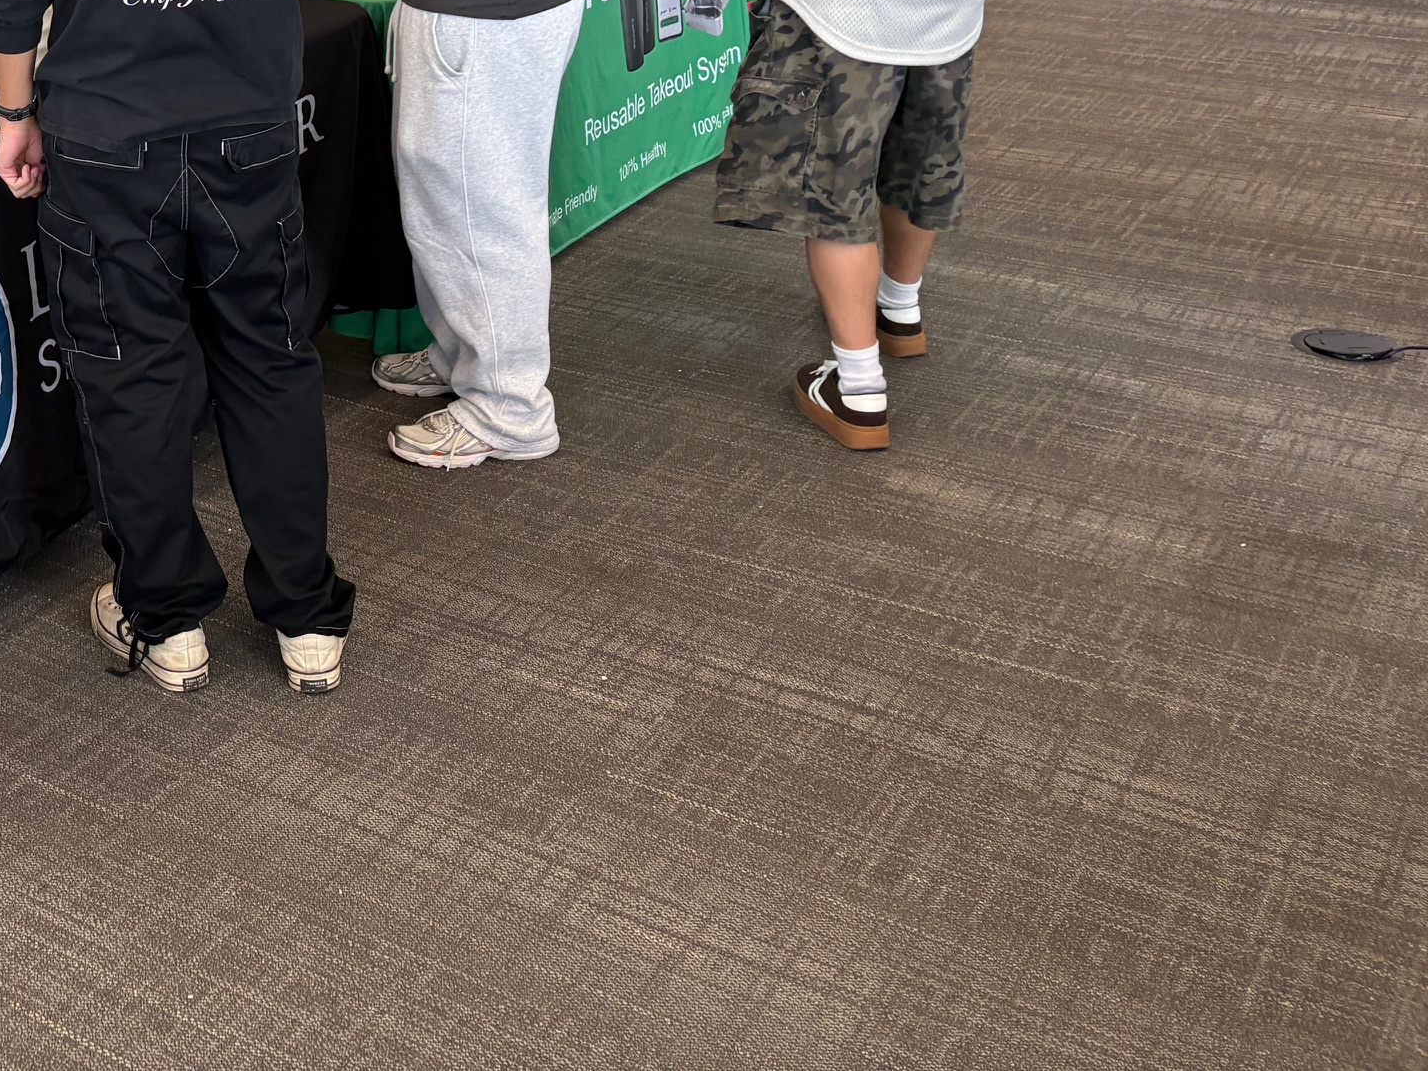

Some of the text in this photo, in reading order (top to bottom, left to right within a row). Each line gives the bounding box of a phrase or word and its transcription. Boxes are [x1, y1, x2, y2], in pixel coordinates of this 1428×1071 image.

[584, 93, 645, 146] Reusable
[647, 63, 694, 108] Takeout
[692, 114, 722, 137] 100%
[564, 184, 598, 216] Friendly
